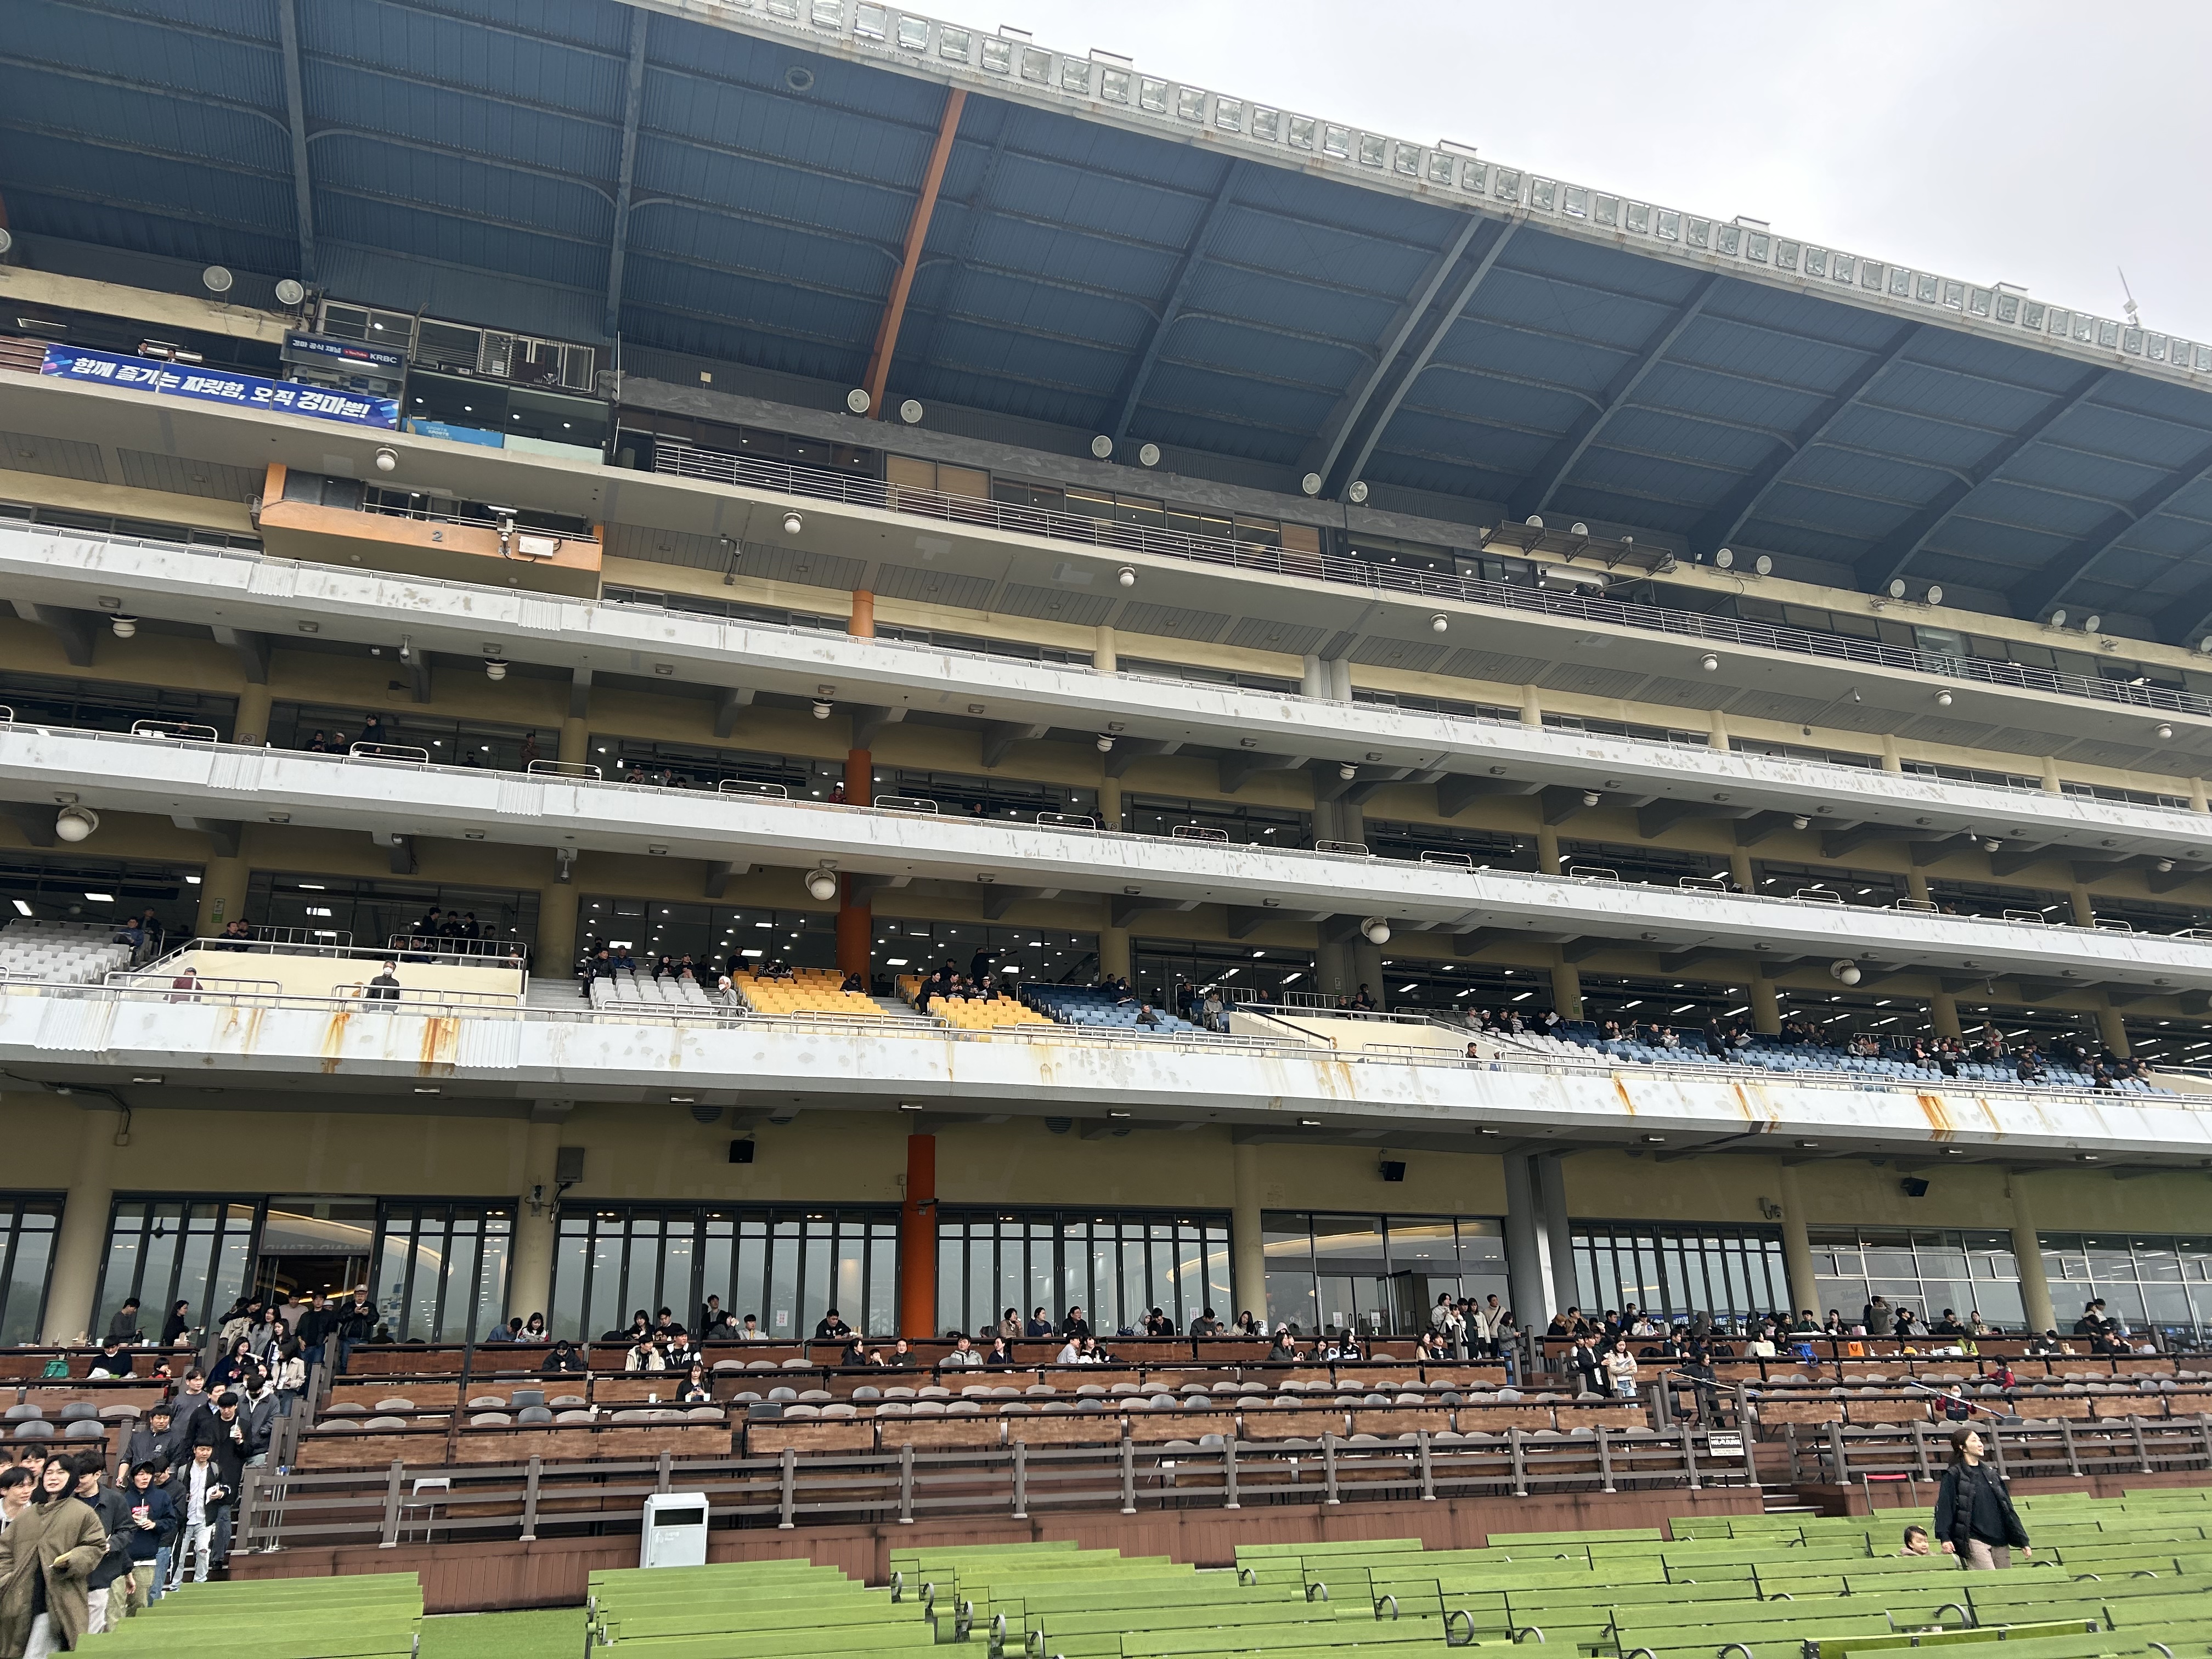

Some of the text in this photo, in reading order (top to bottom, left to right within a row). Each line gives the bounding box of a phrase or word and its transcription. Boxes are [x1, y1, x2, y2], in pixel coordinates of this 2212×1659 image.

[309, 342, 324, 351] 공식
[325, 345, 341, 354] 채널
[370, 353, 397, 364] KRBC
[71, 357, 371, 419] 함께 즐기는 짜릿함, 오직 경마뿐!
[432, 530, 442, 542] 2
